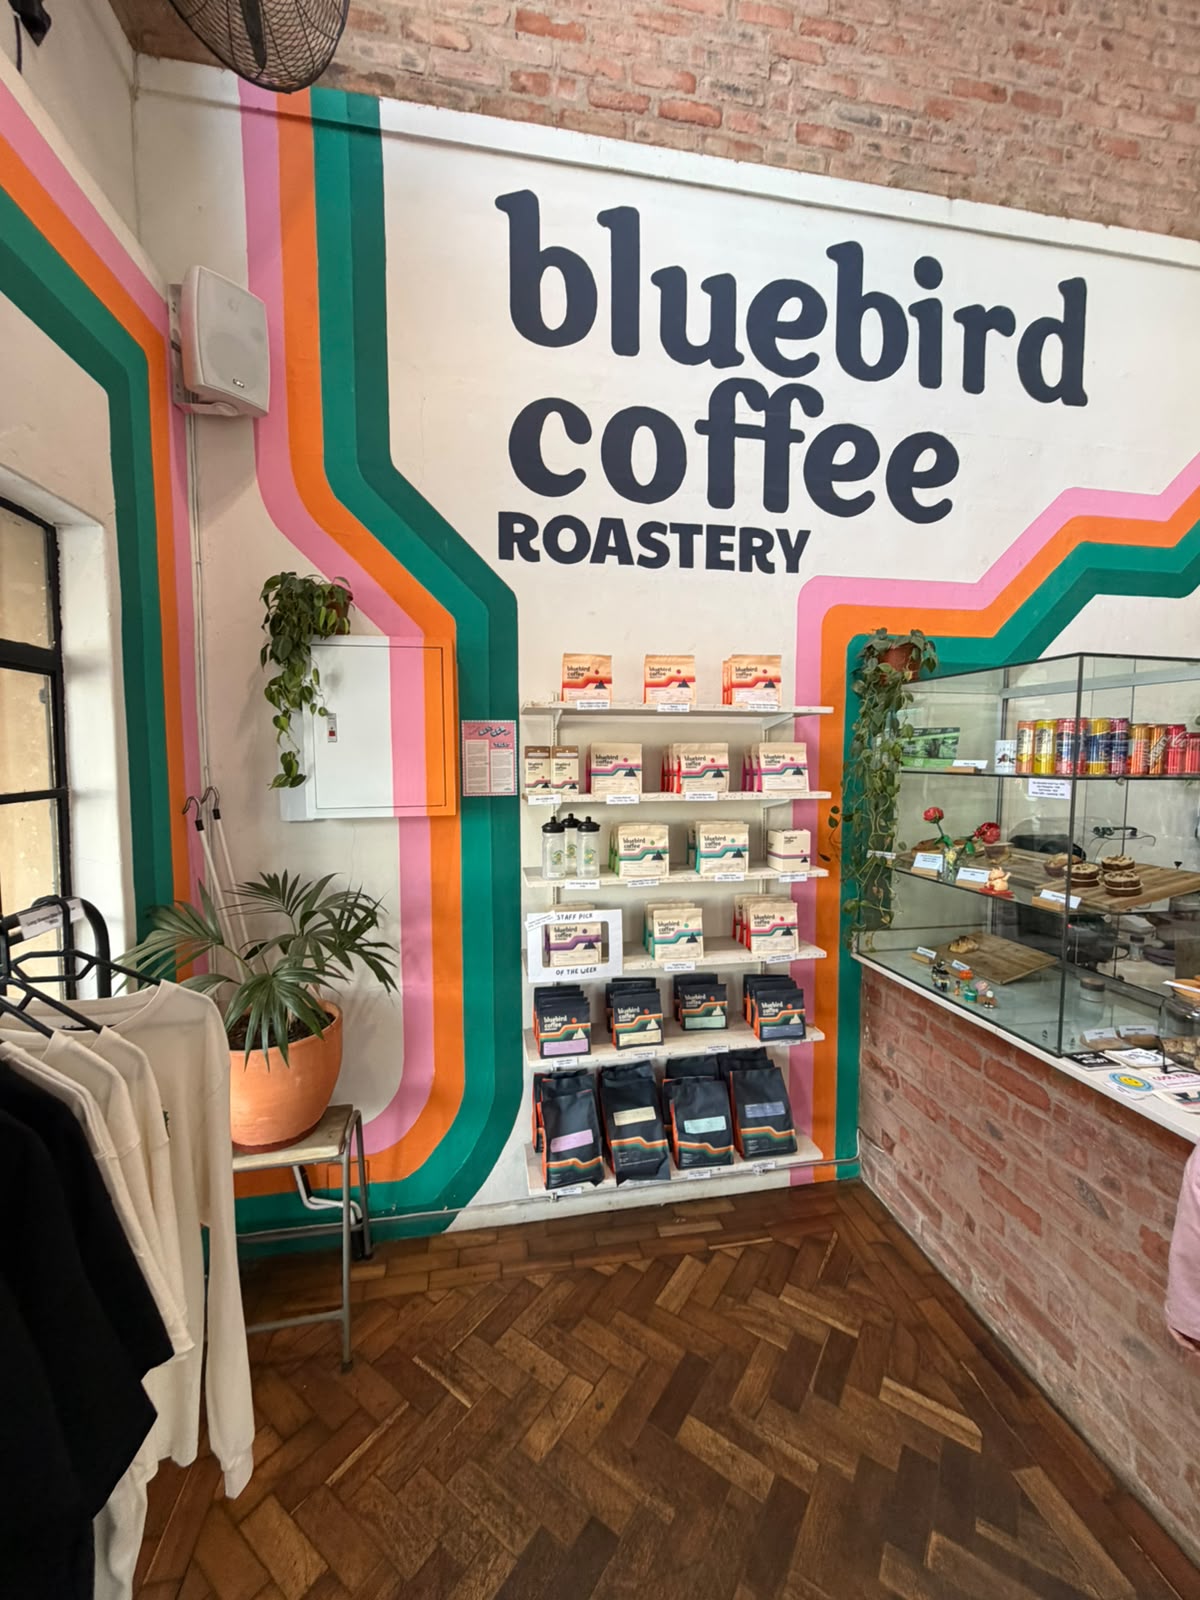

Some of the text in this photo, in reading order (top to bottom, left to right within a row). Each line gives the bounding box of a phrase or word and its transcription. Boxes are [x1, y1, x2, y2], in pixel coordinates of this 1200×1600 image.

[495, 189, 1088, 407] bluebird
[508, 377, 960, 524] coffee
[498, 511, 811, 575] ROASTERY
